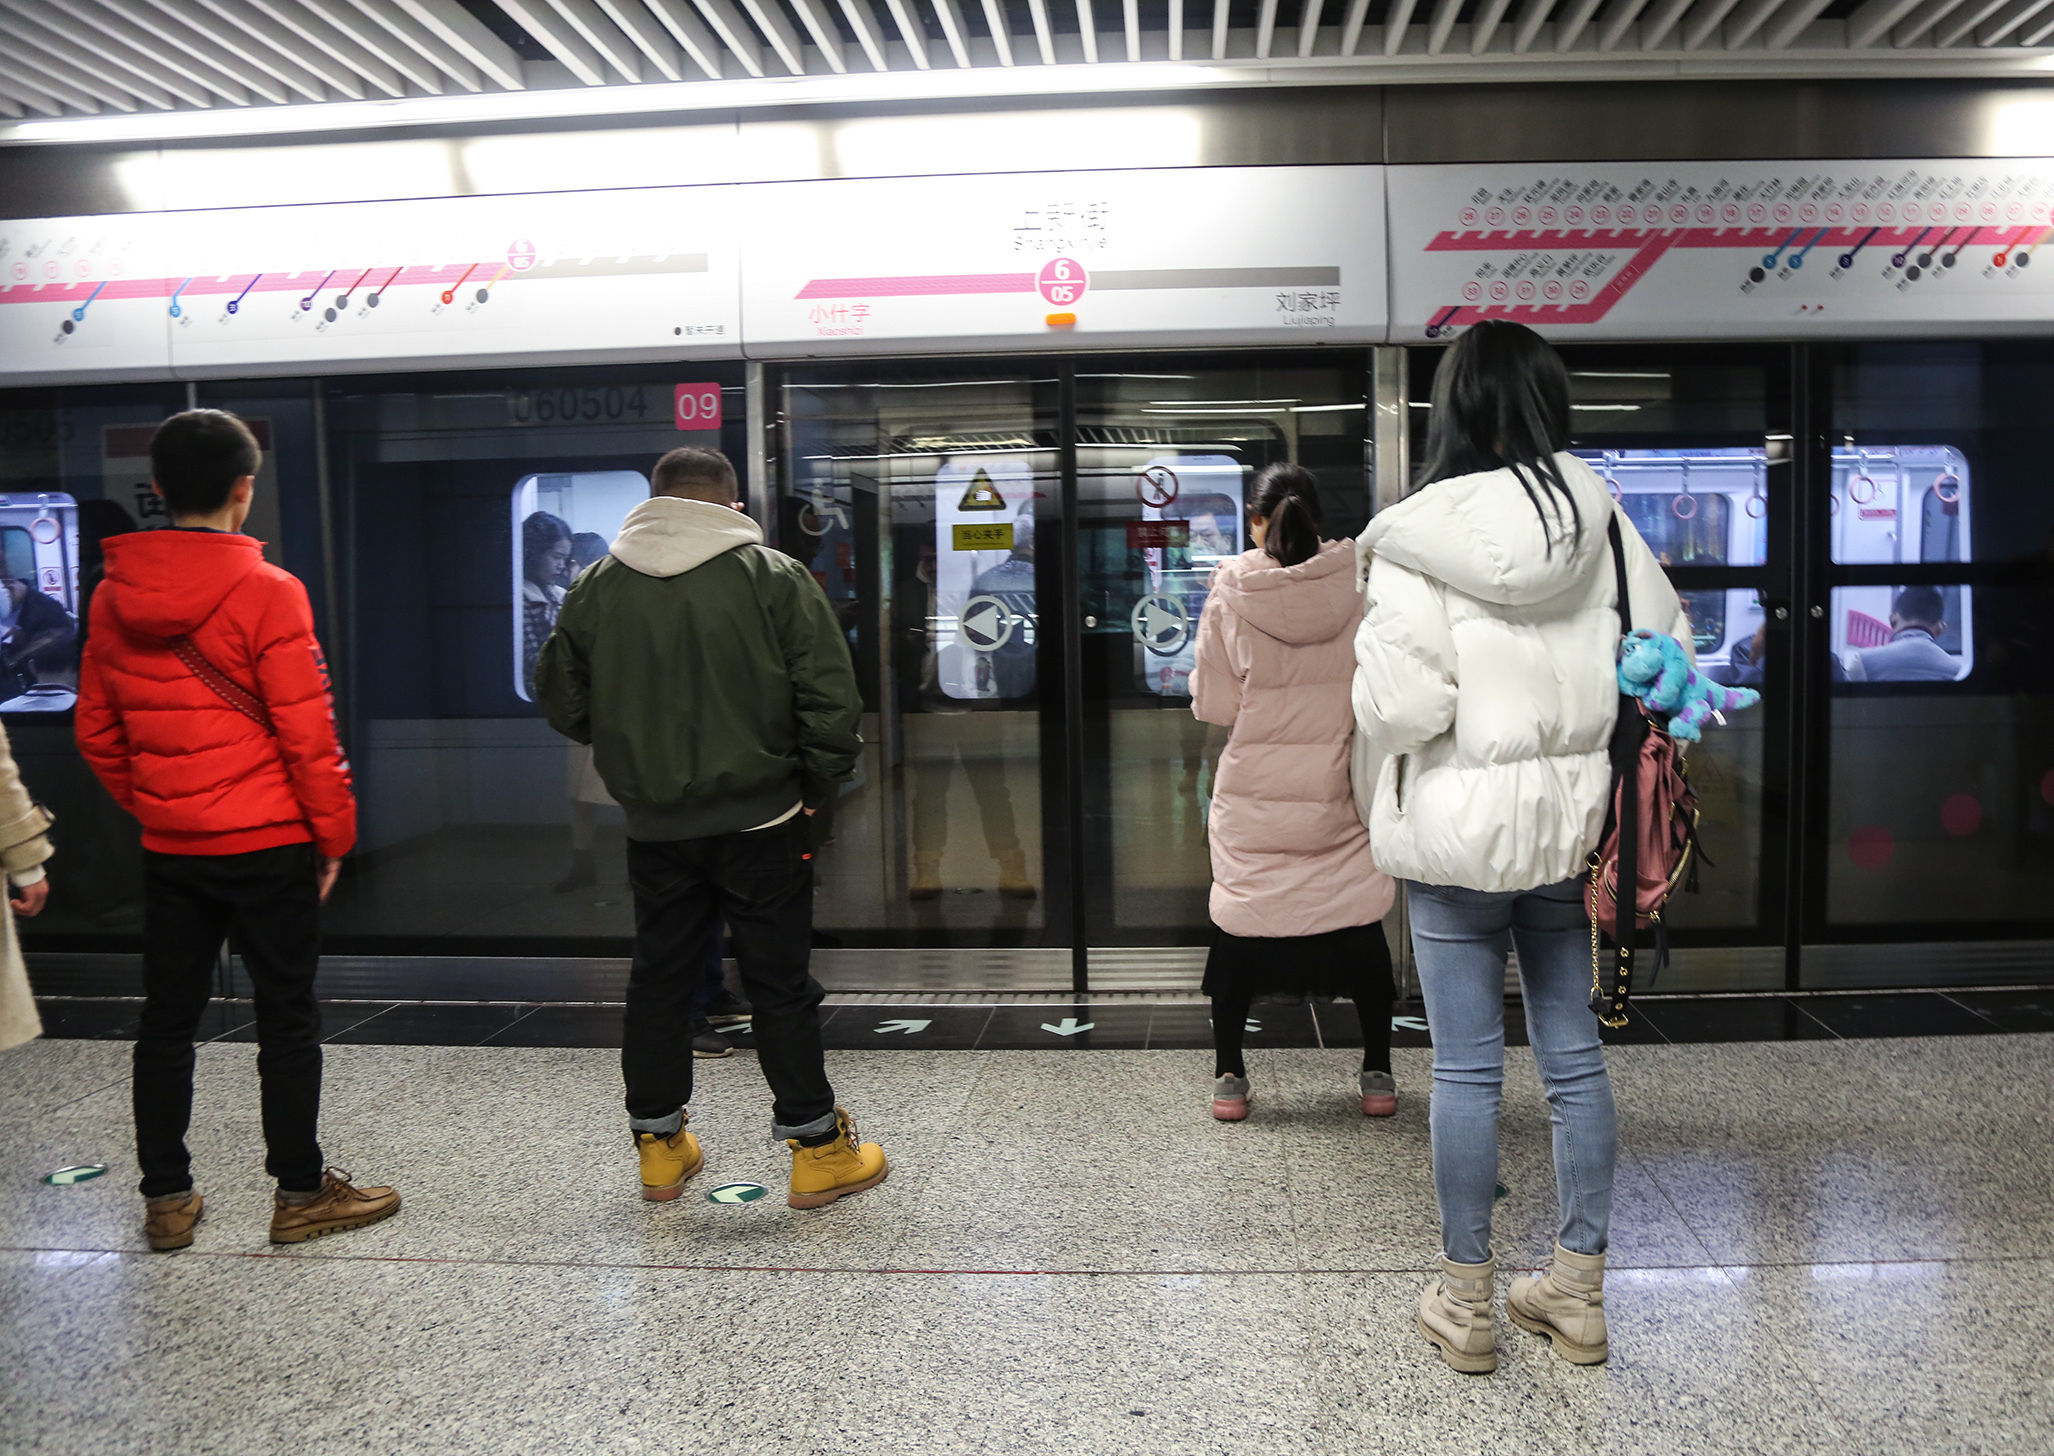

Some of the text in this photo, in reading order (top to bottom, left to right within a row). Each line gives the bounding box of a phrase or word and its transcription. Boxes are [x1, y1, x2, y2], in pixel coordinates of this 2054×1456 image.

[1013, 200, 1109, 231] 上新街
[1054, 259, 1071, 280] 6
[1051, 286, 1074, 302] 05
[1275, 290, 1341, 312] 刘家坪
[808, 302, 871, 324] 小什字
[1282, 315, 1336, 327] Liujiaping
[678, 392, 718, 420] 09
[962, 528, 1004, 540] 当心夹手
